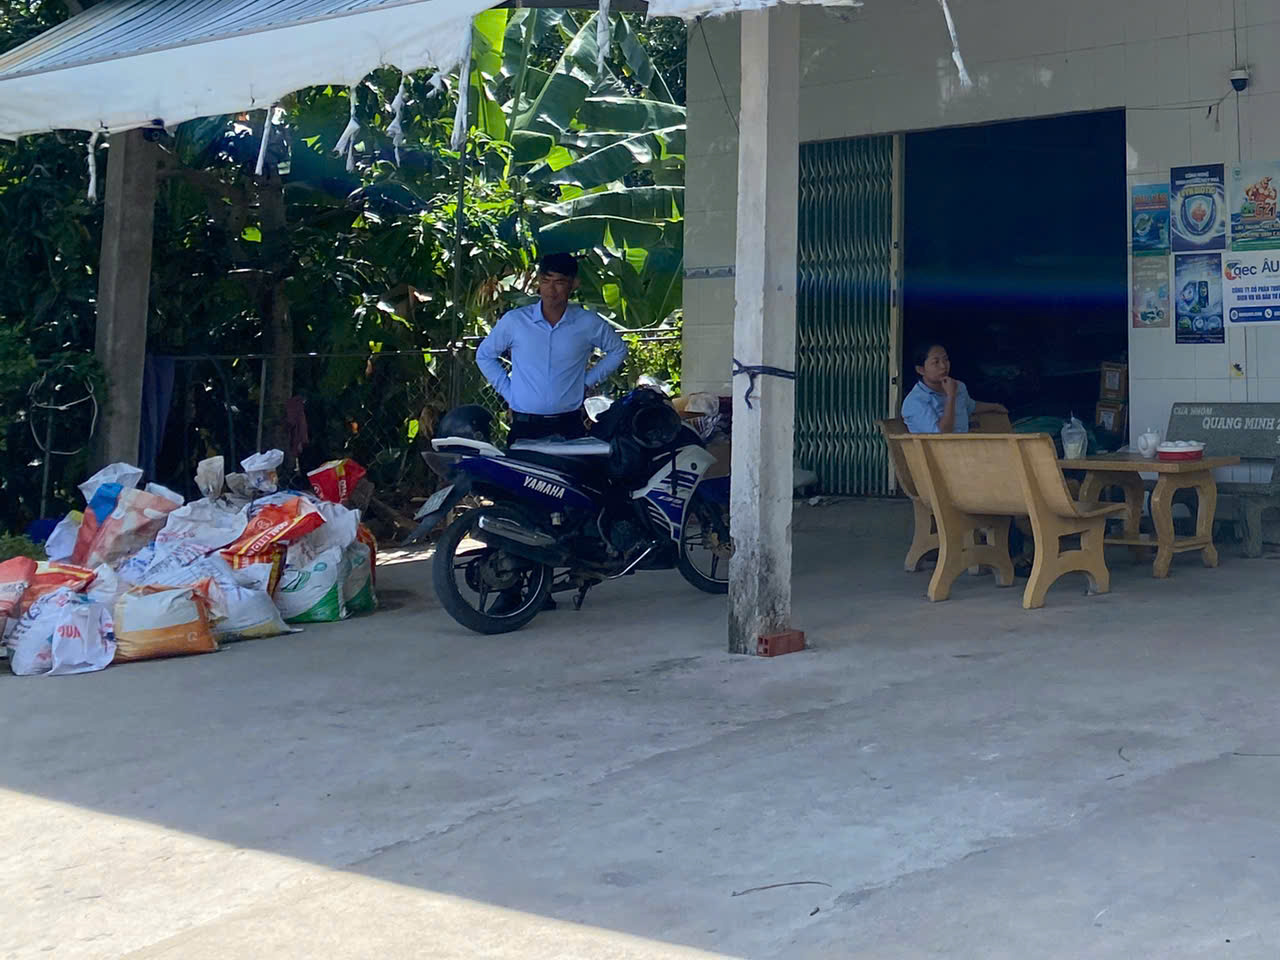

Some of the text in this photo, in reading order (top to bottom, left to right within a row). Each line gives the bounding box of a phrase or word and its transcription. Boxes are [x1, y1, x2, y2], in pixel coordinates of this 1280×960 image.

[1262, 258, 1280, 273] ÂU
[1202, 417, 1242, 431] QUANG
[1244, 417, 1275, 431] MINH
[523, 475, 566, 500] YAMAHA
